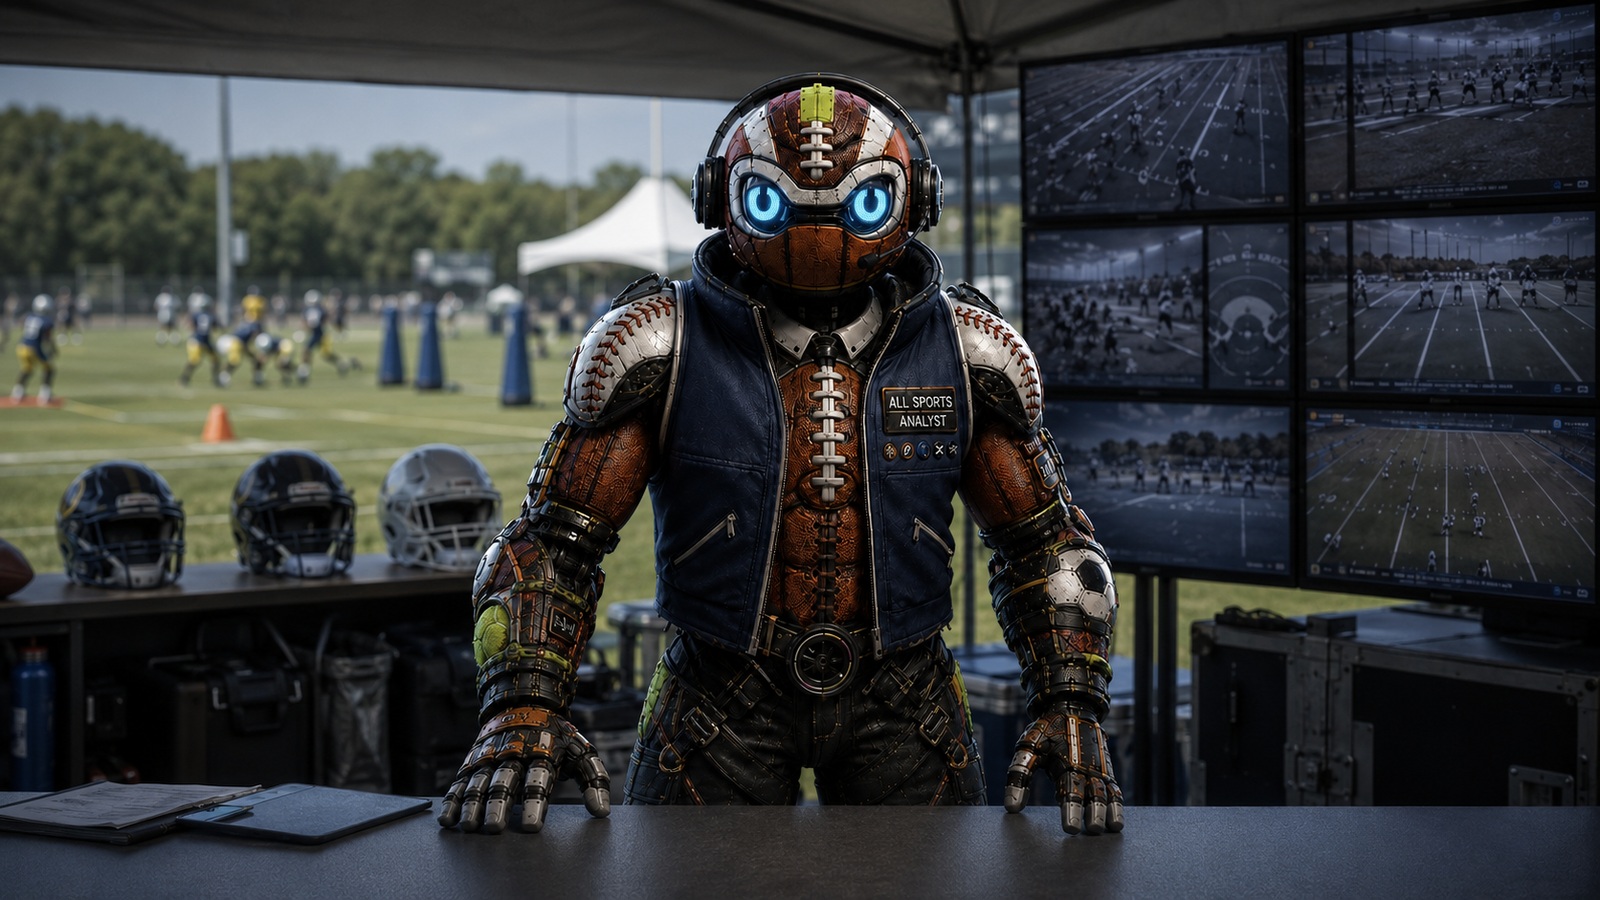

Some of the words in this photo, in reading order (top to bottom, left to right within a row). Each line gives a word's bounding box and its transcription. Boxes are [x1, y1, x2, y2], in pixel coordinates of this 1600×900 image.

[889, 396, 909, 409] ALL
[912, 395, 953, 408] SPORTS
[899, 414, 947, 428] ANALYST
